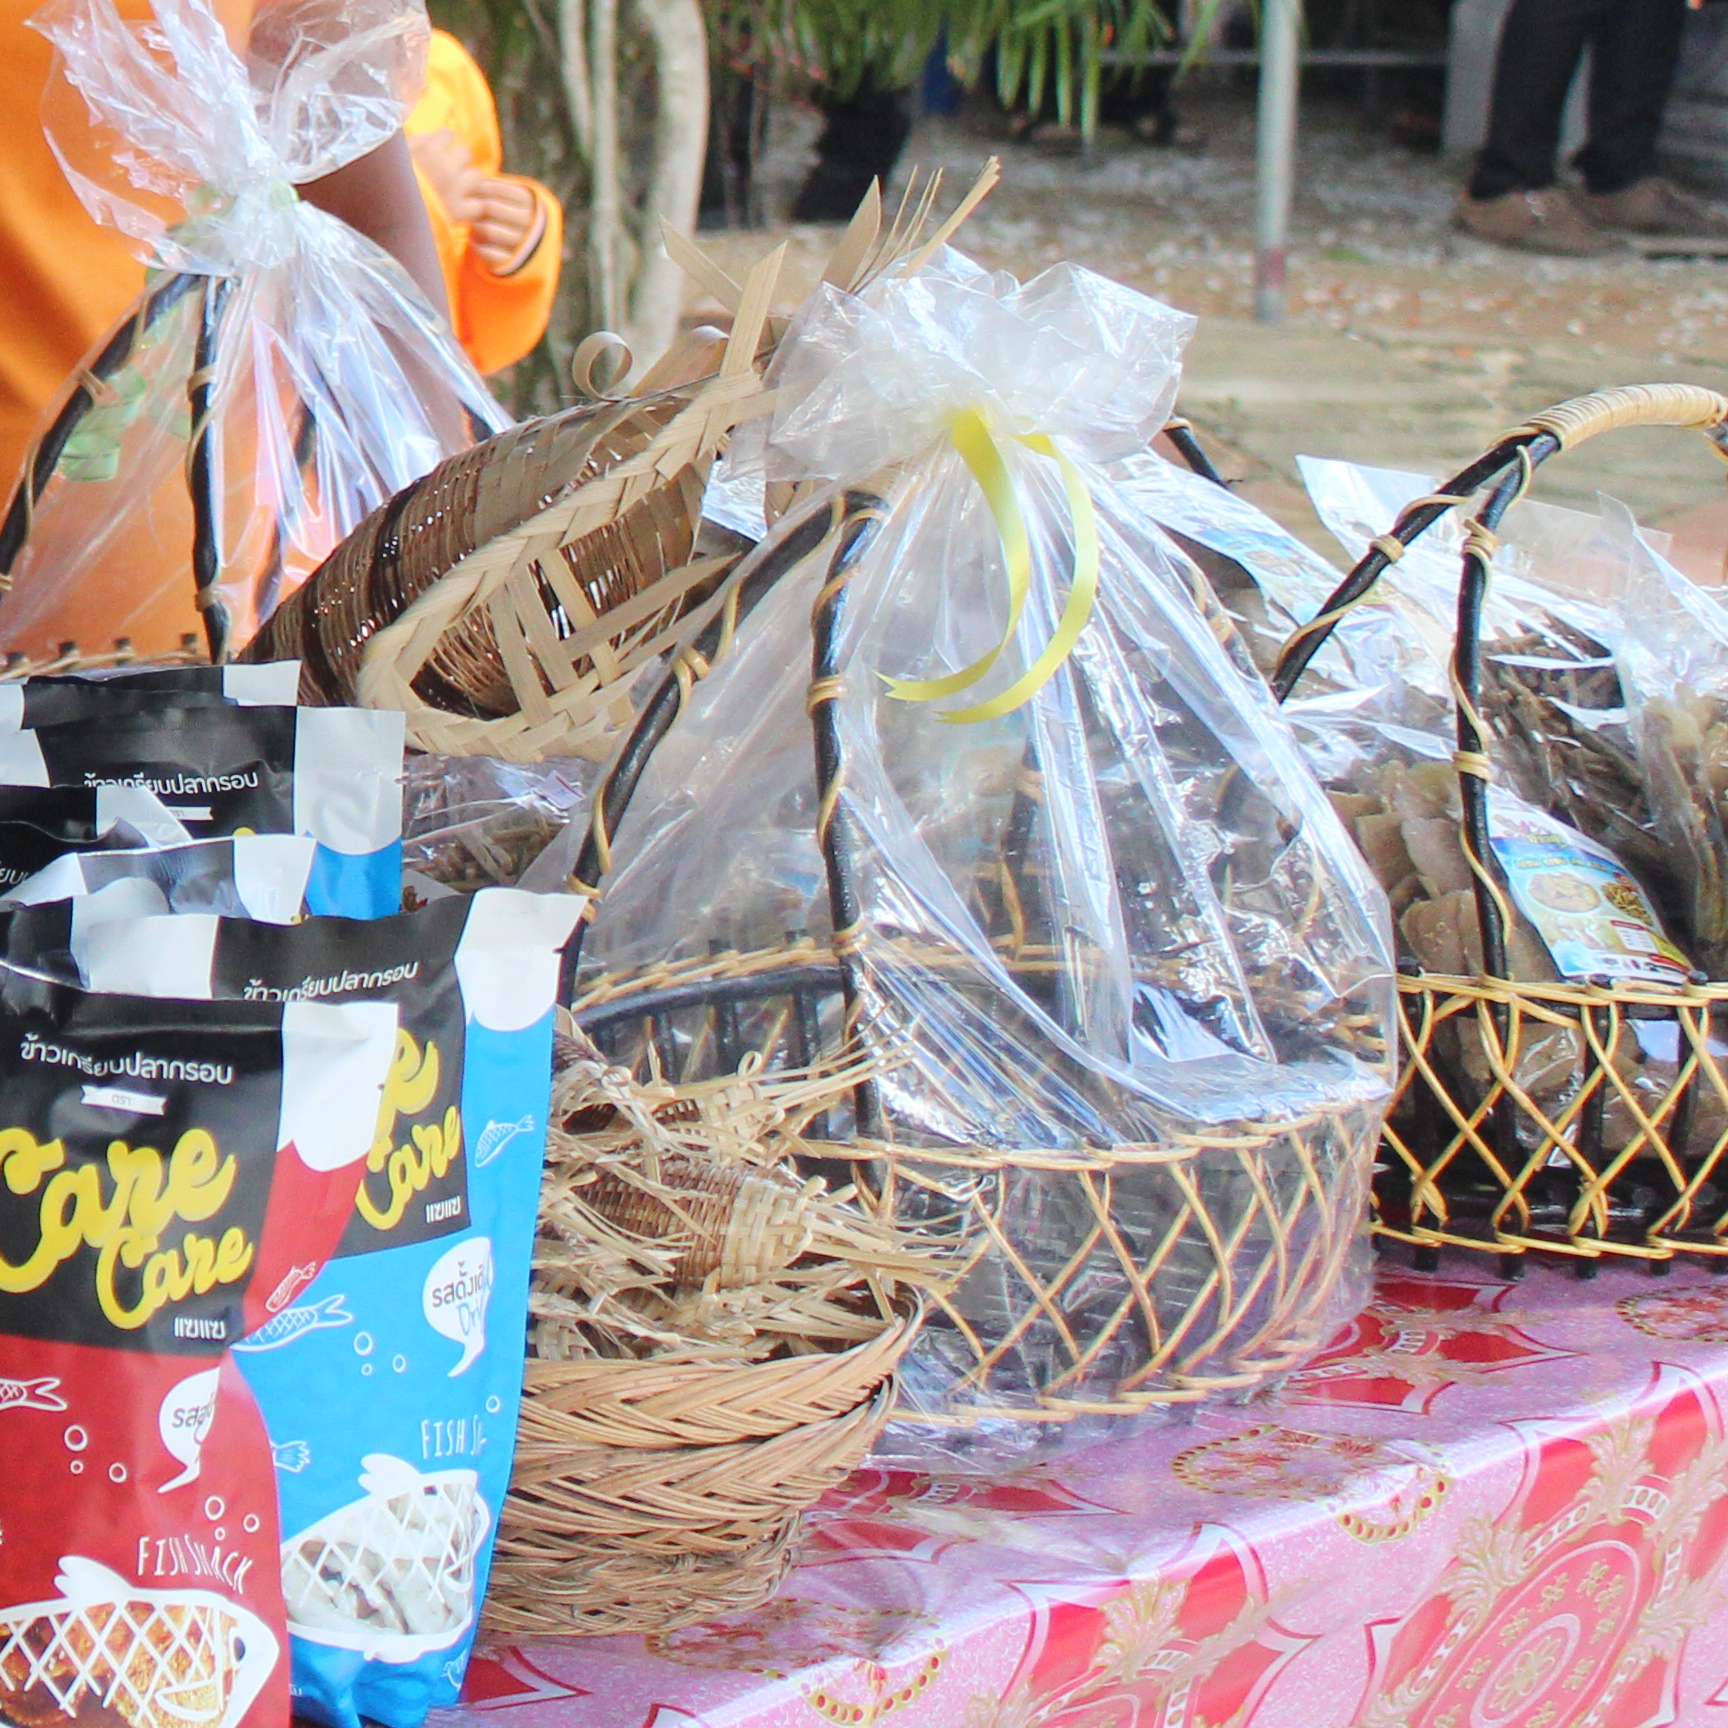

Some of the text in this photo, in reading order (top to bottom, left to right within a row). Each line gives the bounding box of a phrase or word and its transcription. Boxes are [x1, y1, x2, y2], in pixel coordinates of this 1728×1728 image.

[96, 1227, 254, 1330] Care
[421, 1418, 465, 1460] FISH
[137, 1533, 253, 1595] FISH SNACK
